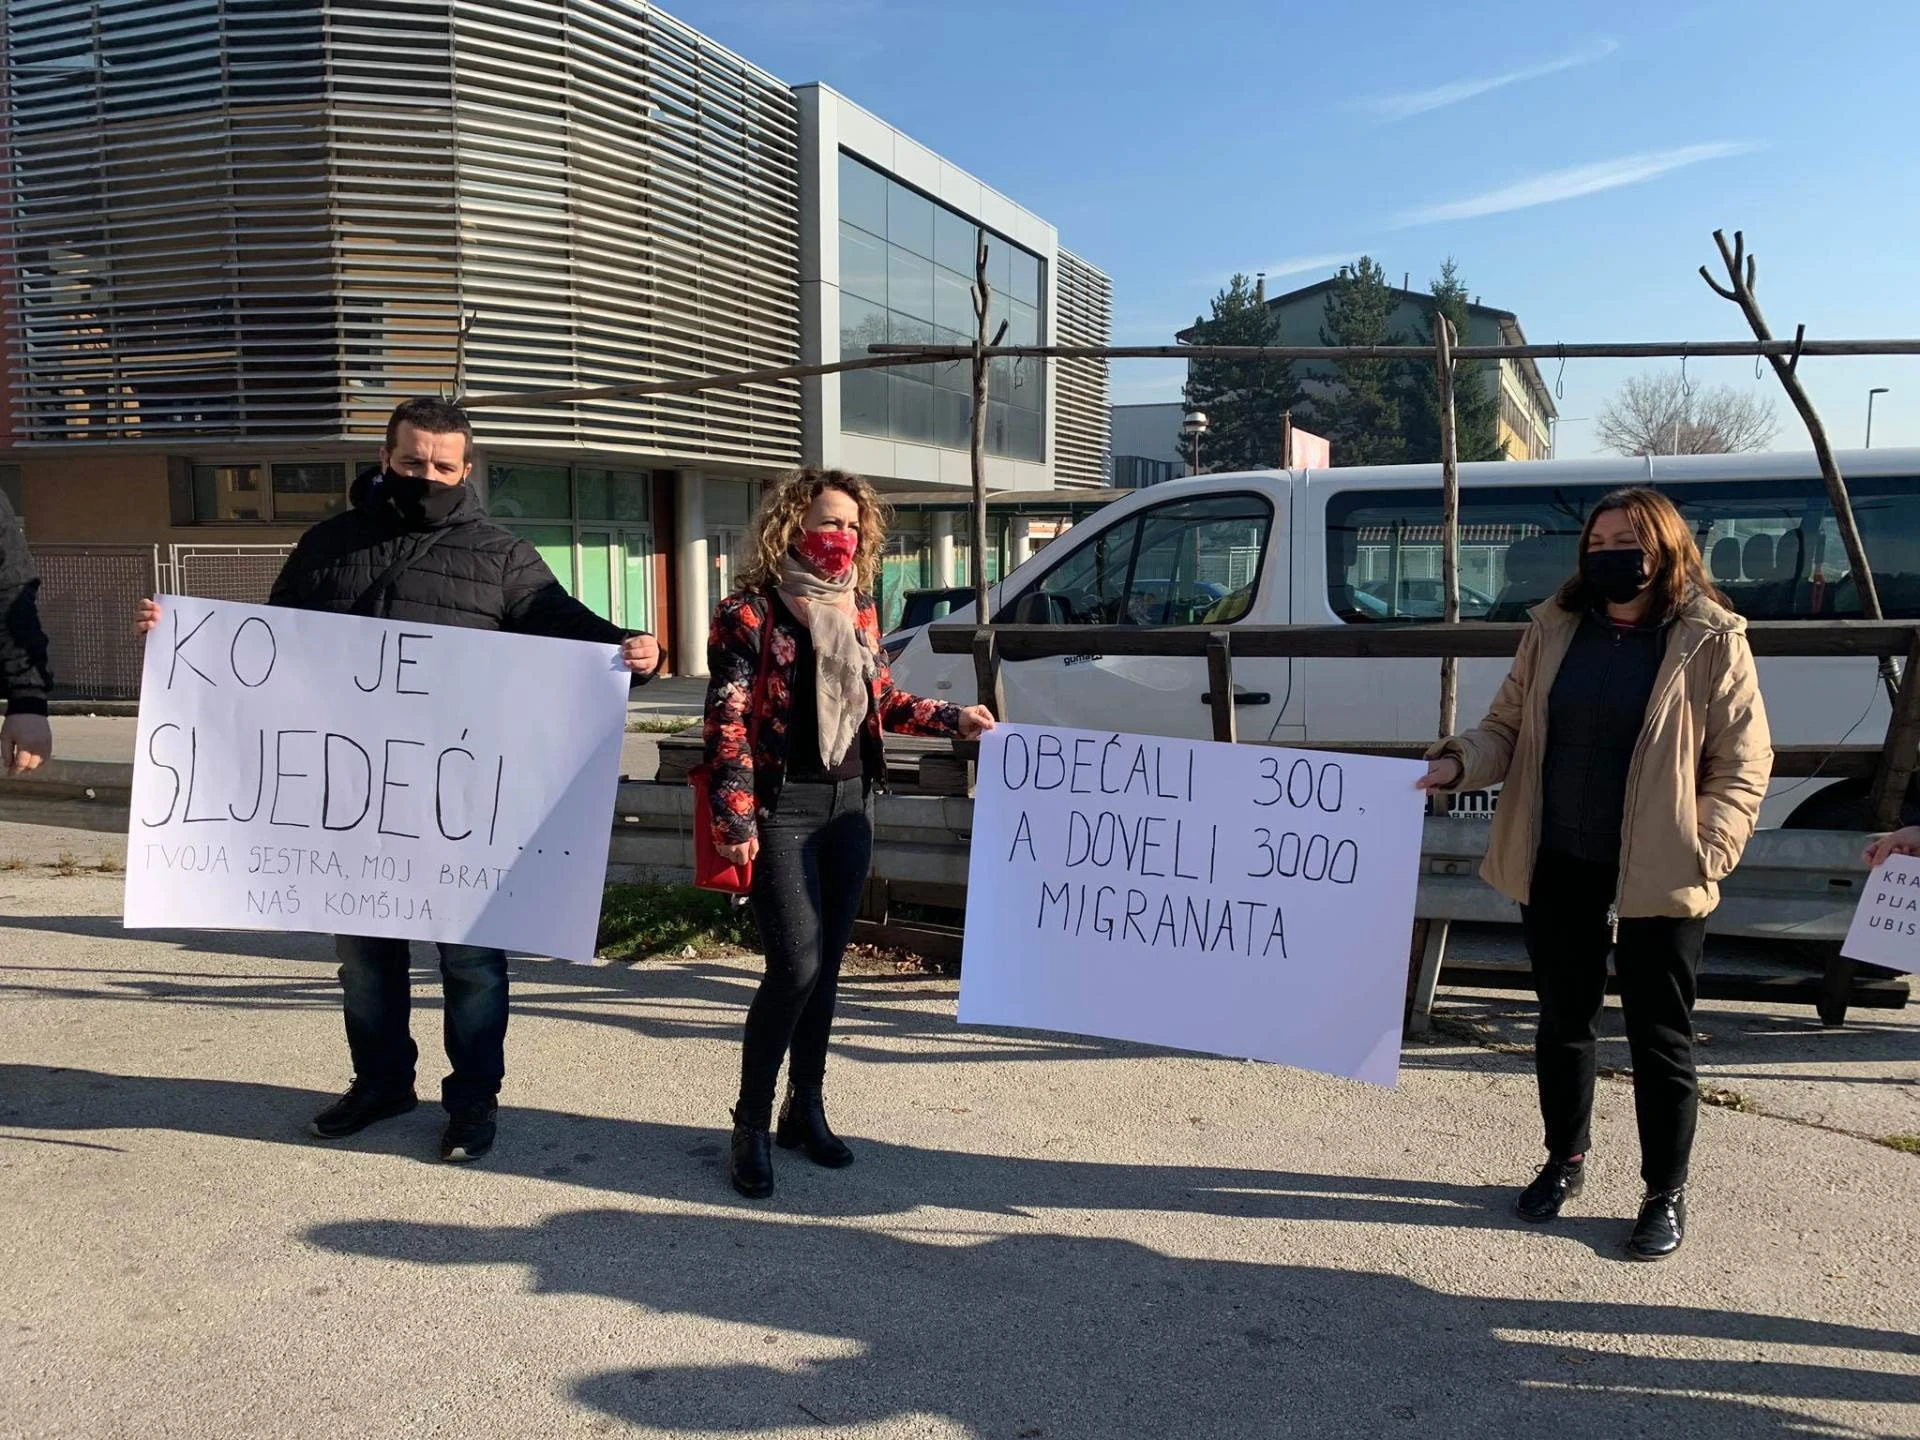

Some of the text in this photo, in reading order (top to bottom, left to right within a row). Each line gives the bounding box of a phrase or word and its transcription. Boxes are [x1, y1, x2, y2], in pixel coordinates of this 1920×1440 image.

[168, 609, 433, 695] KO JE
[1003, 733, 1193, 801] OBEĆALI
[145, 843, 230, 874] TVOJA
[249, 846, 350, 881] SESTRA,
[362, 855, 411, 884] MOJ
[1008, 811, 1358, 884] A DOVELI 3000
[247, 885, 301, 914] NAŠ
[1037, 882, 1288, 959] MIGRANATA
[1869, 916, 1916, 936] UBIS
